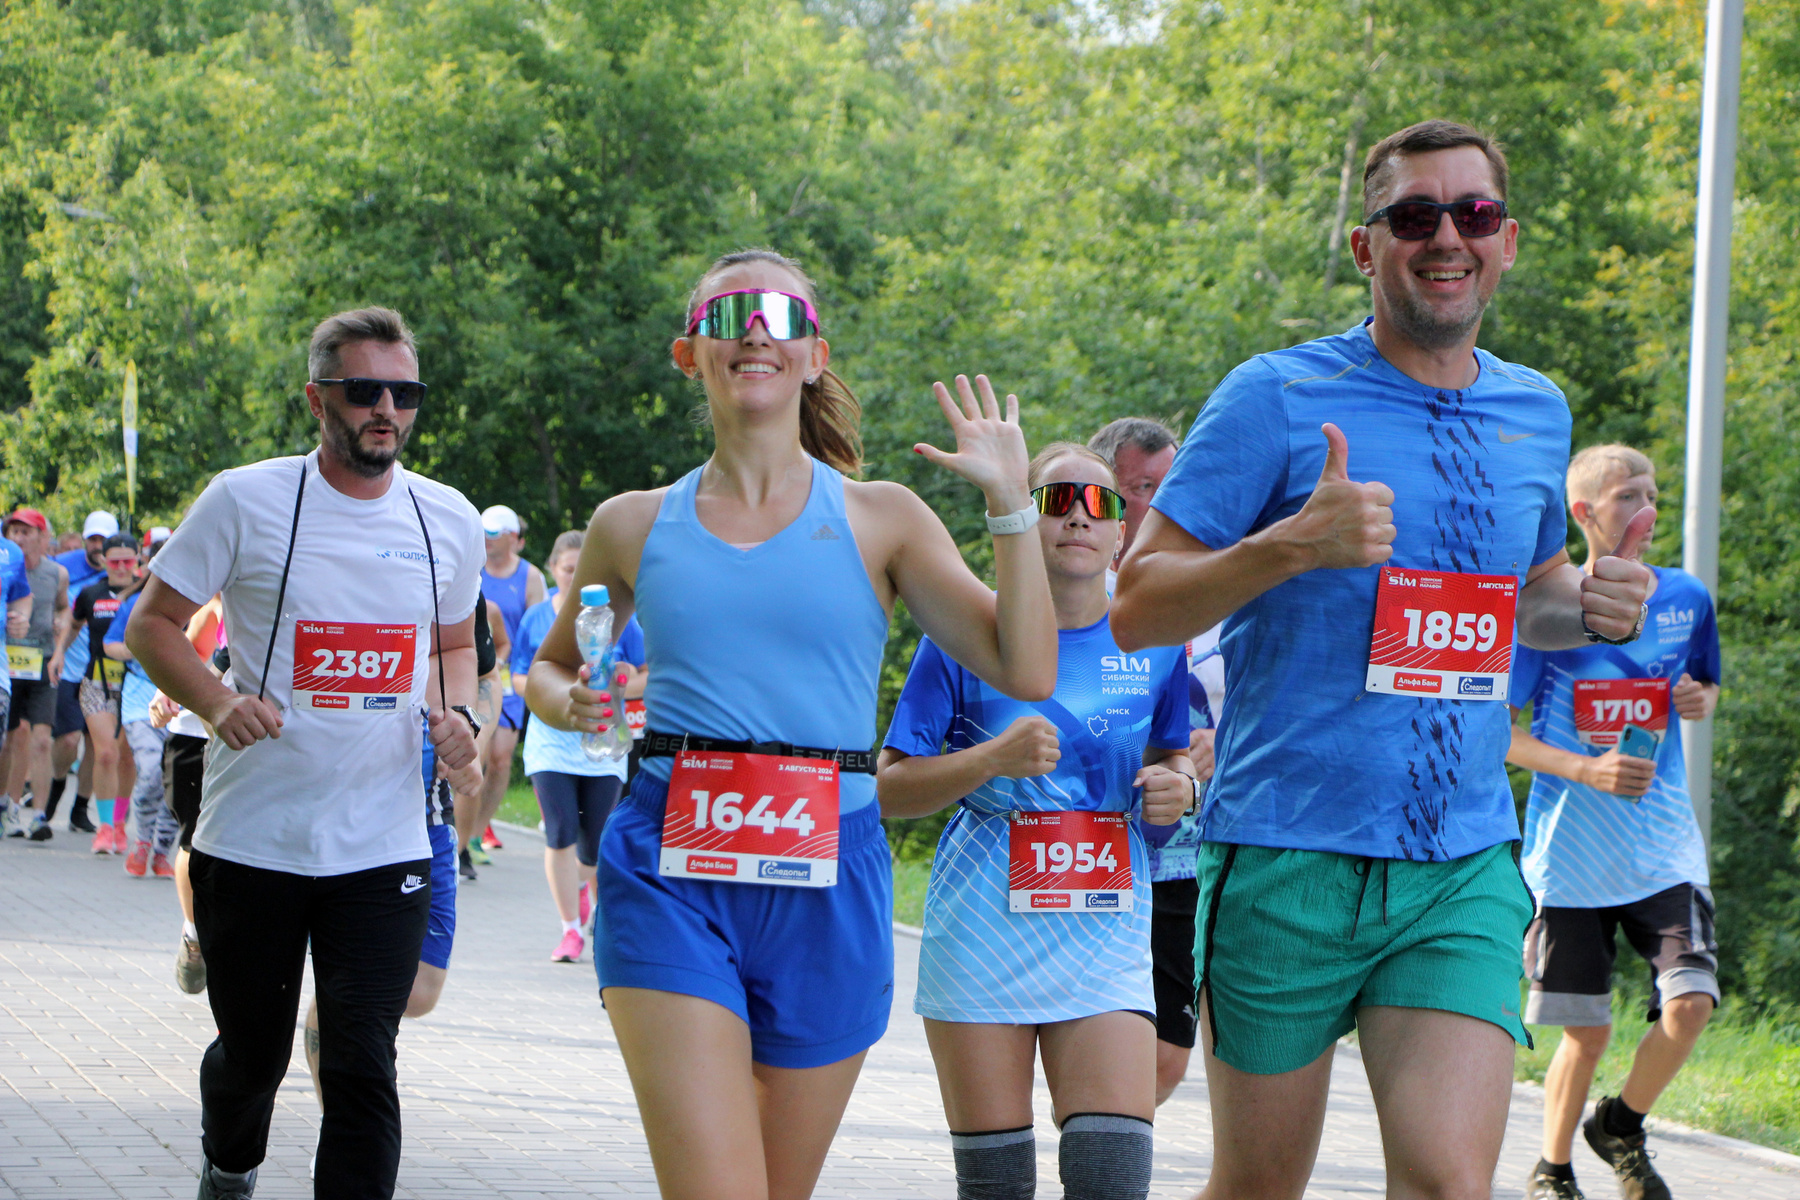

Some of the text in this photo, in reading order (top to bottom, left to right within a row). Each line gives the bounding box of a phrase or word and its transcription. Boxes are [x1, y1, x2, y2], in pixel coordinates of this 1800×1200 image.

[1403, 608, 1498, 653] 1859
[312, 648, 403, 679] 2387
[1101, 674, 1150, 682] СИБИРСКИЙ
[1397, 676, 1439, 687] Альфа Банк
[1102, 687, 1150, 696] МАРАФОН
[1464, 683, 1492, 692] Следопыт
[315, 697, 333, 705] Альфа
[370, 698, 396, 708] Следопыт
[1591, 698, 1653, 722] 1710
[784, 764, 817, 774] АВГУСТА
[817, 766, 834, 775] 2024
[691, 789, 816, 837] 1644
[1030, 841, 1118, 873] 1954
[689, 859, 734, 870] Альфа Банк
[767, 866, 809, 877] Следопыт
[405, 873, 423, 887] NIKE
[1053, 896, 1068, 904] Банк
[1091, 897, 1118, 906] Следопыт
